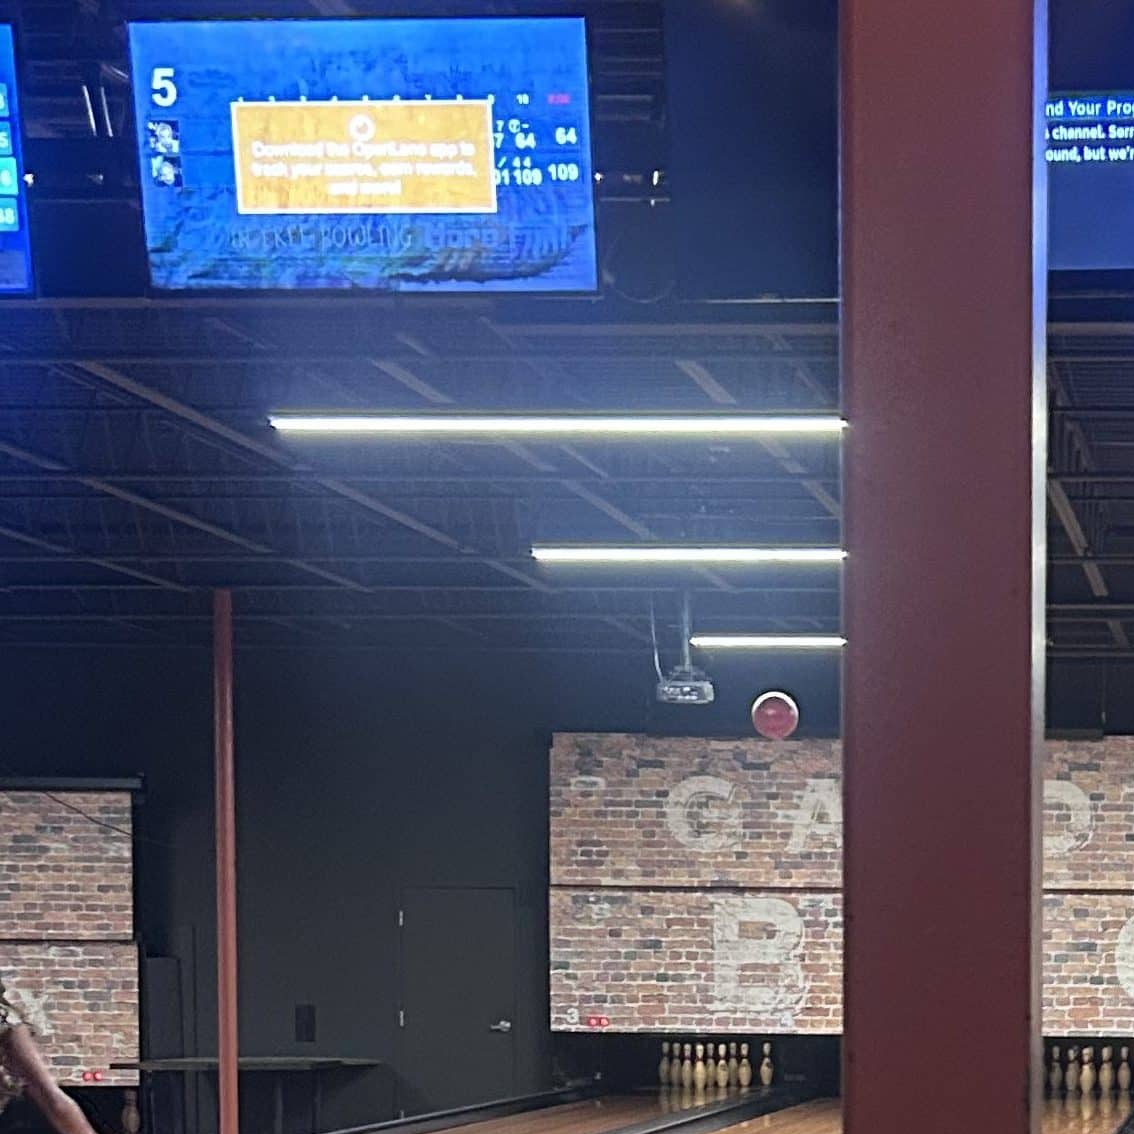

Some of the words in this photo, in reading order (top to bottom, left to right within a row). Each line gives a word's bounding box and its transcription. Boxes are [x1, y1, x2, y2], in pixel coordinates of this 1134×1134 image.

[151, 67, 178, 108] 5
[1068, 100, 1102, 116] Your
[555, 127, 577, 145] 64
[1084, 145, 1107, 161] but
[547, 162, 579, 181] 109
[566, 1007, 581, 1024] 3
